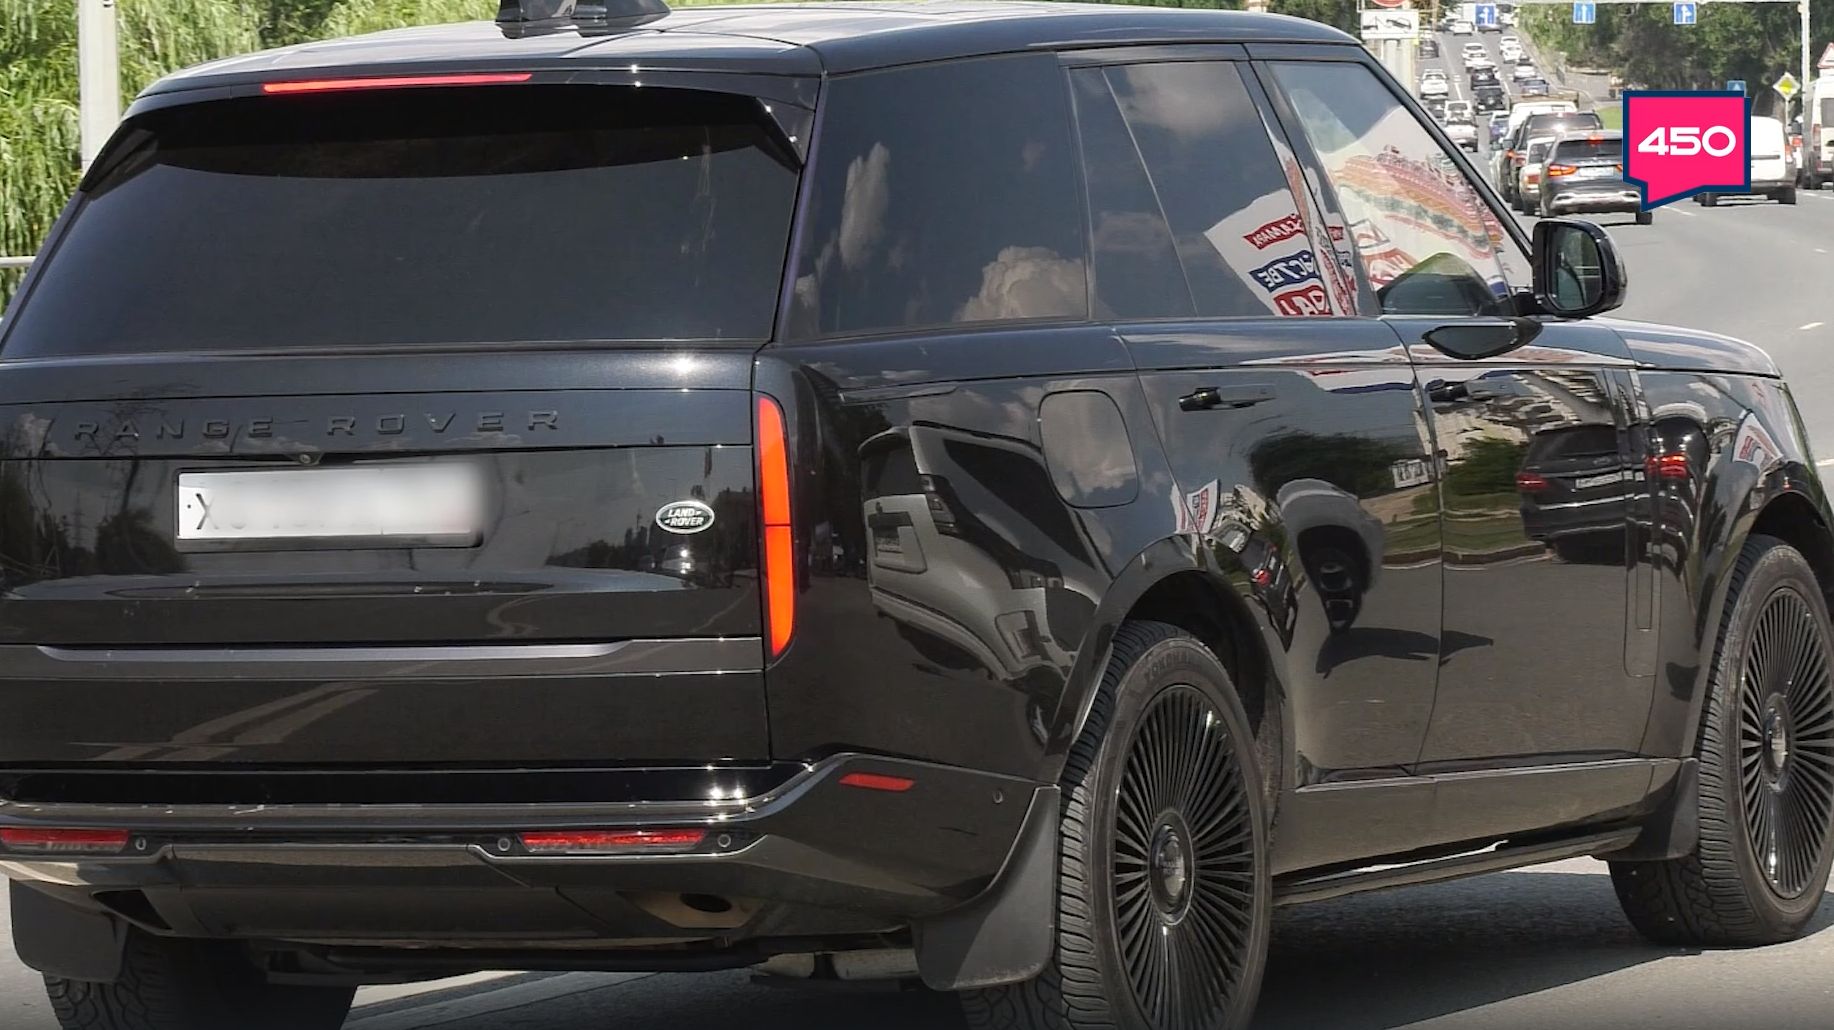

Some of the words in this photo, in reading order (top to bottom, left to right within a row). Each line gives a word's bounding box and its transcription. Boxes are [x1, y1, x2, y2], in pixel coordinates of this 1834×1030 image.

[74, 415, 274, 441] RANGE
[326, 409, 559, 436] ROVER
[668, 508, 695, 518] LAND
[670, 517, 704, 526] ROVER
